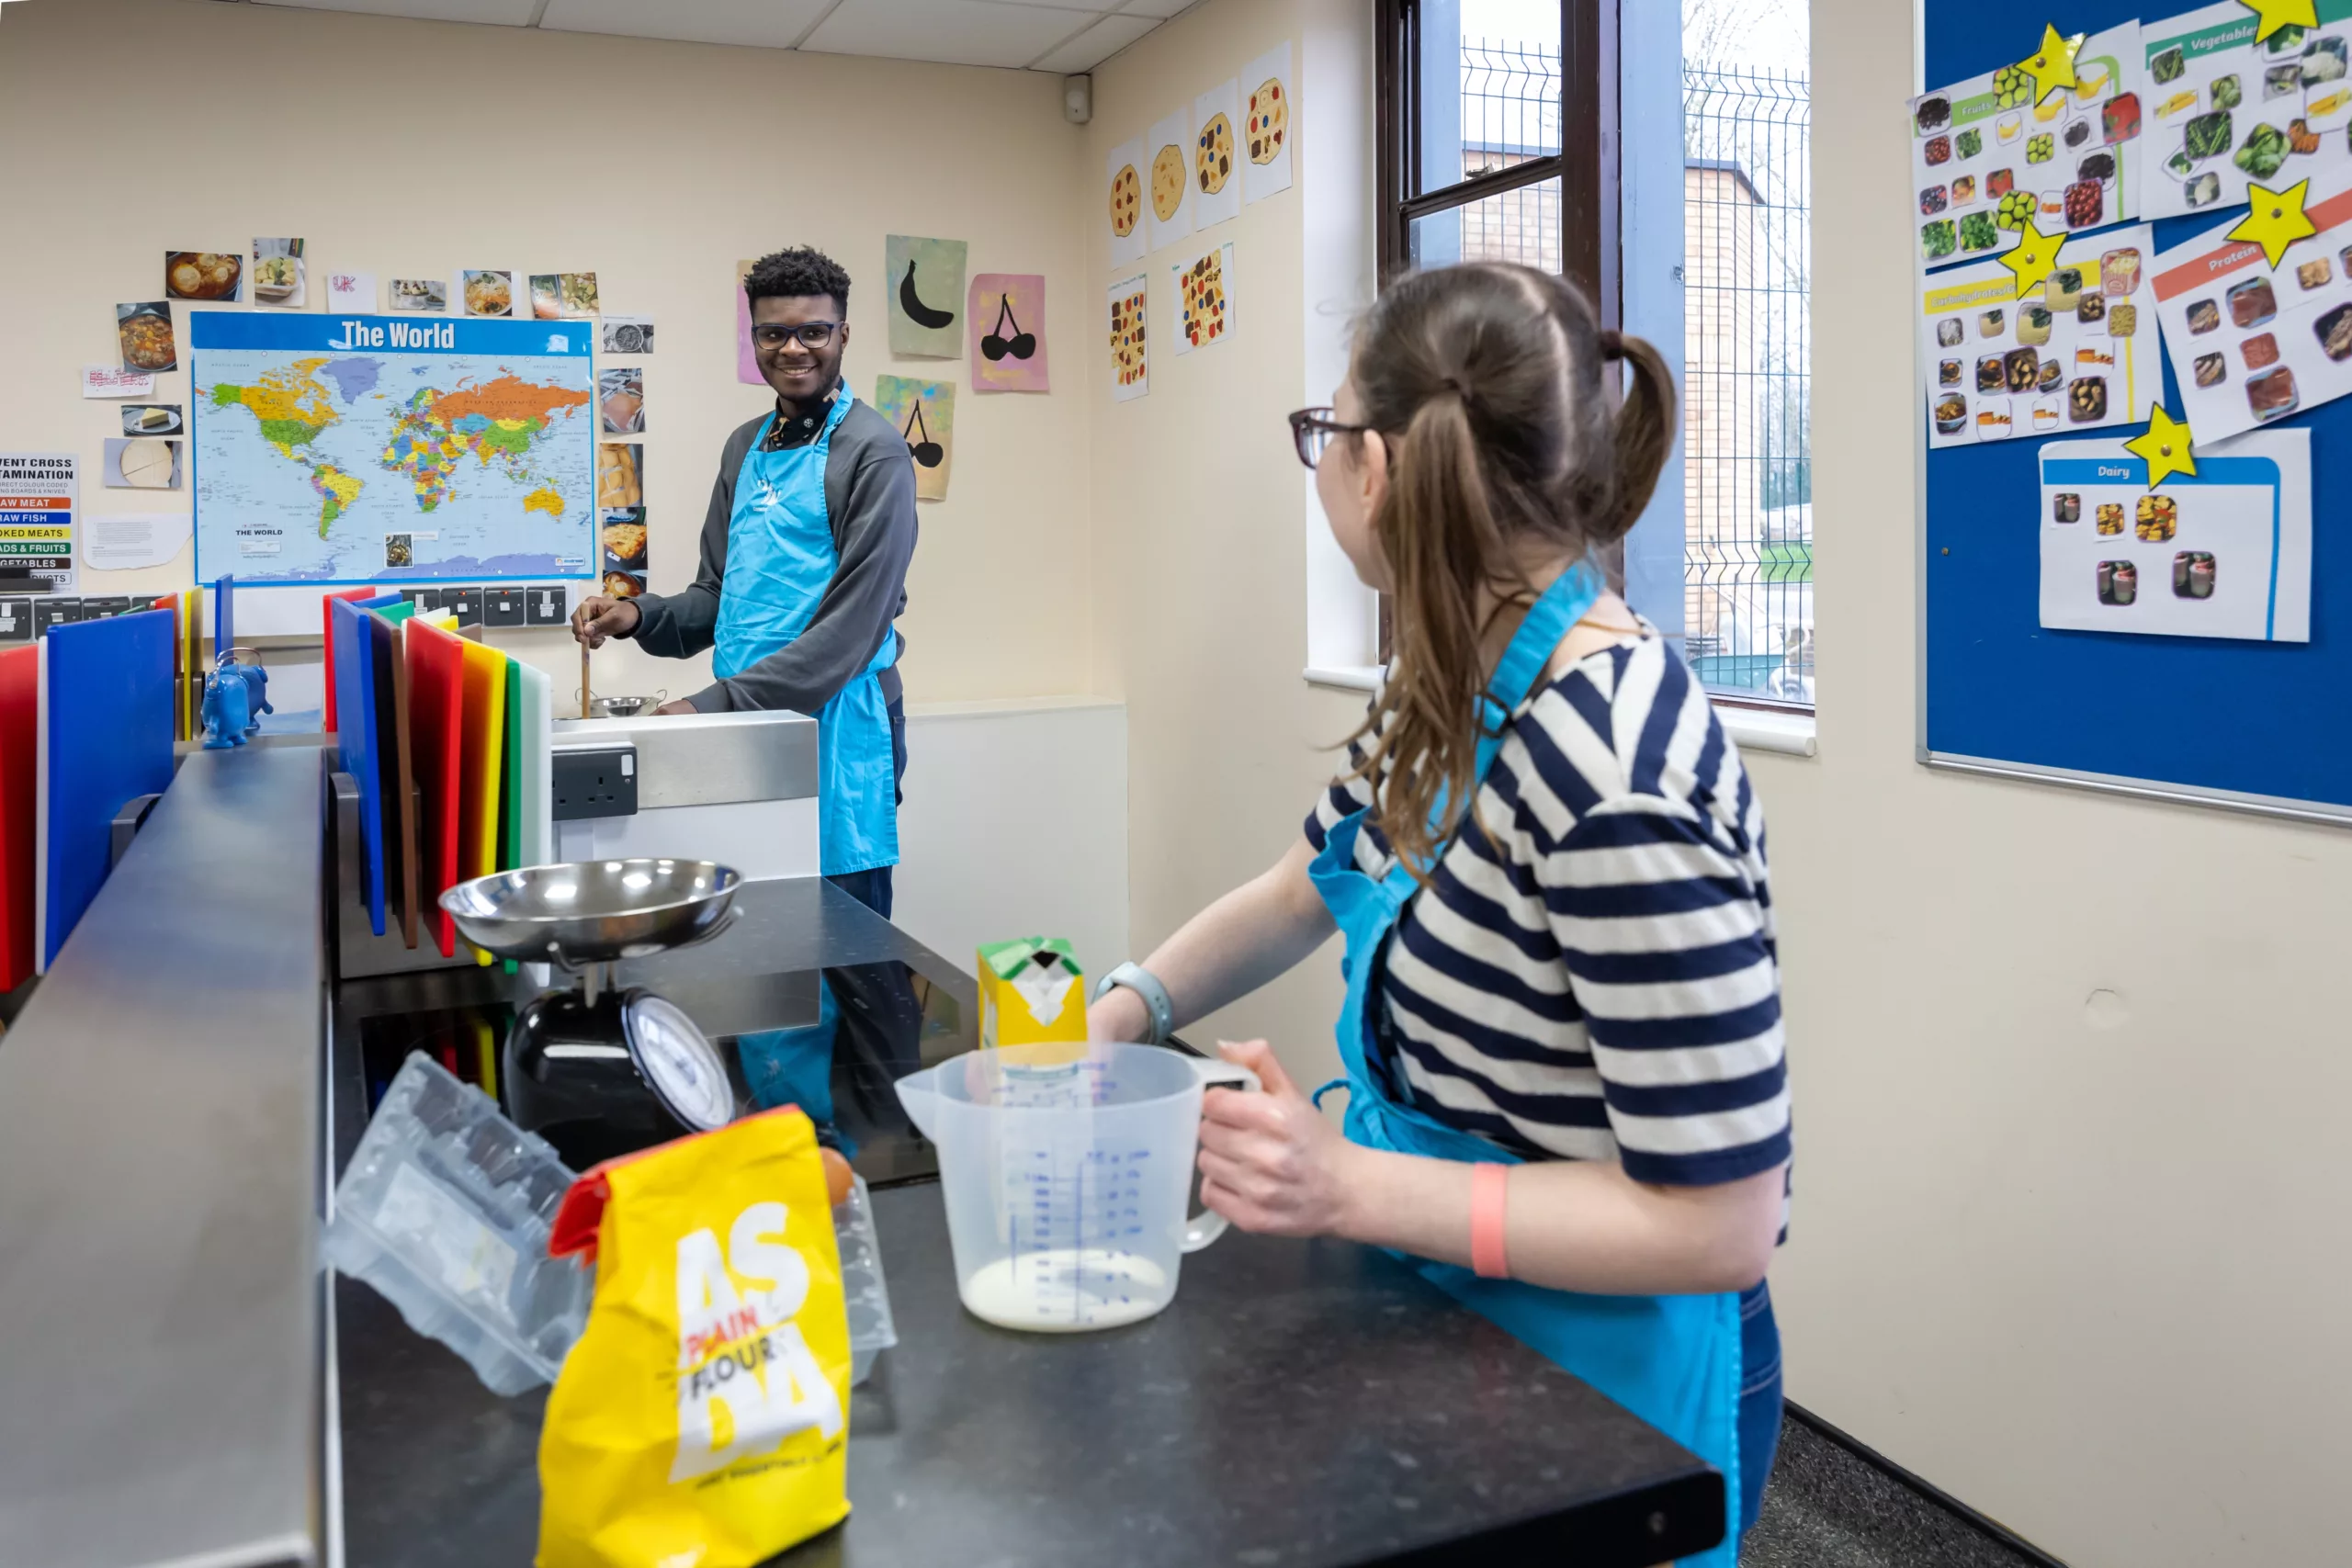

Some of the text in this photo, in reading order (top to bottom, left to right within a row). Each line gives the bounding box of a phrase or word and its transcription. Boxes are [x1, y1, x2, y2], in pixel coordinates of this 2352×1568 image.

[1962, 102, 1992, 117] Fruits
[2208, 245, 2257, 272] Protein
[333, 276, 356, 292] UK
[342, 321, 455, 349] The World
[30, 458, 72, 468] CROSS
[2098, 465, 2131, 479] Dairy
[19, 499, 51, 507] MEAT
[22, 513, 48, 523] FISH
[28, 529, 63, 537] MEATS
[19, 544, 27, 553] &
[29, 544, 66, 553] FRUITS
[684, 1304, 760, 1368] PLAIN
[690, 1334, 778, 1401] FLOUR
